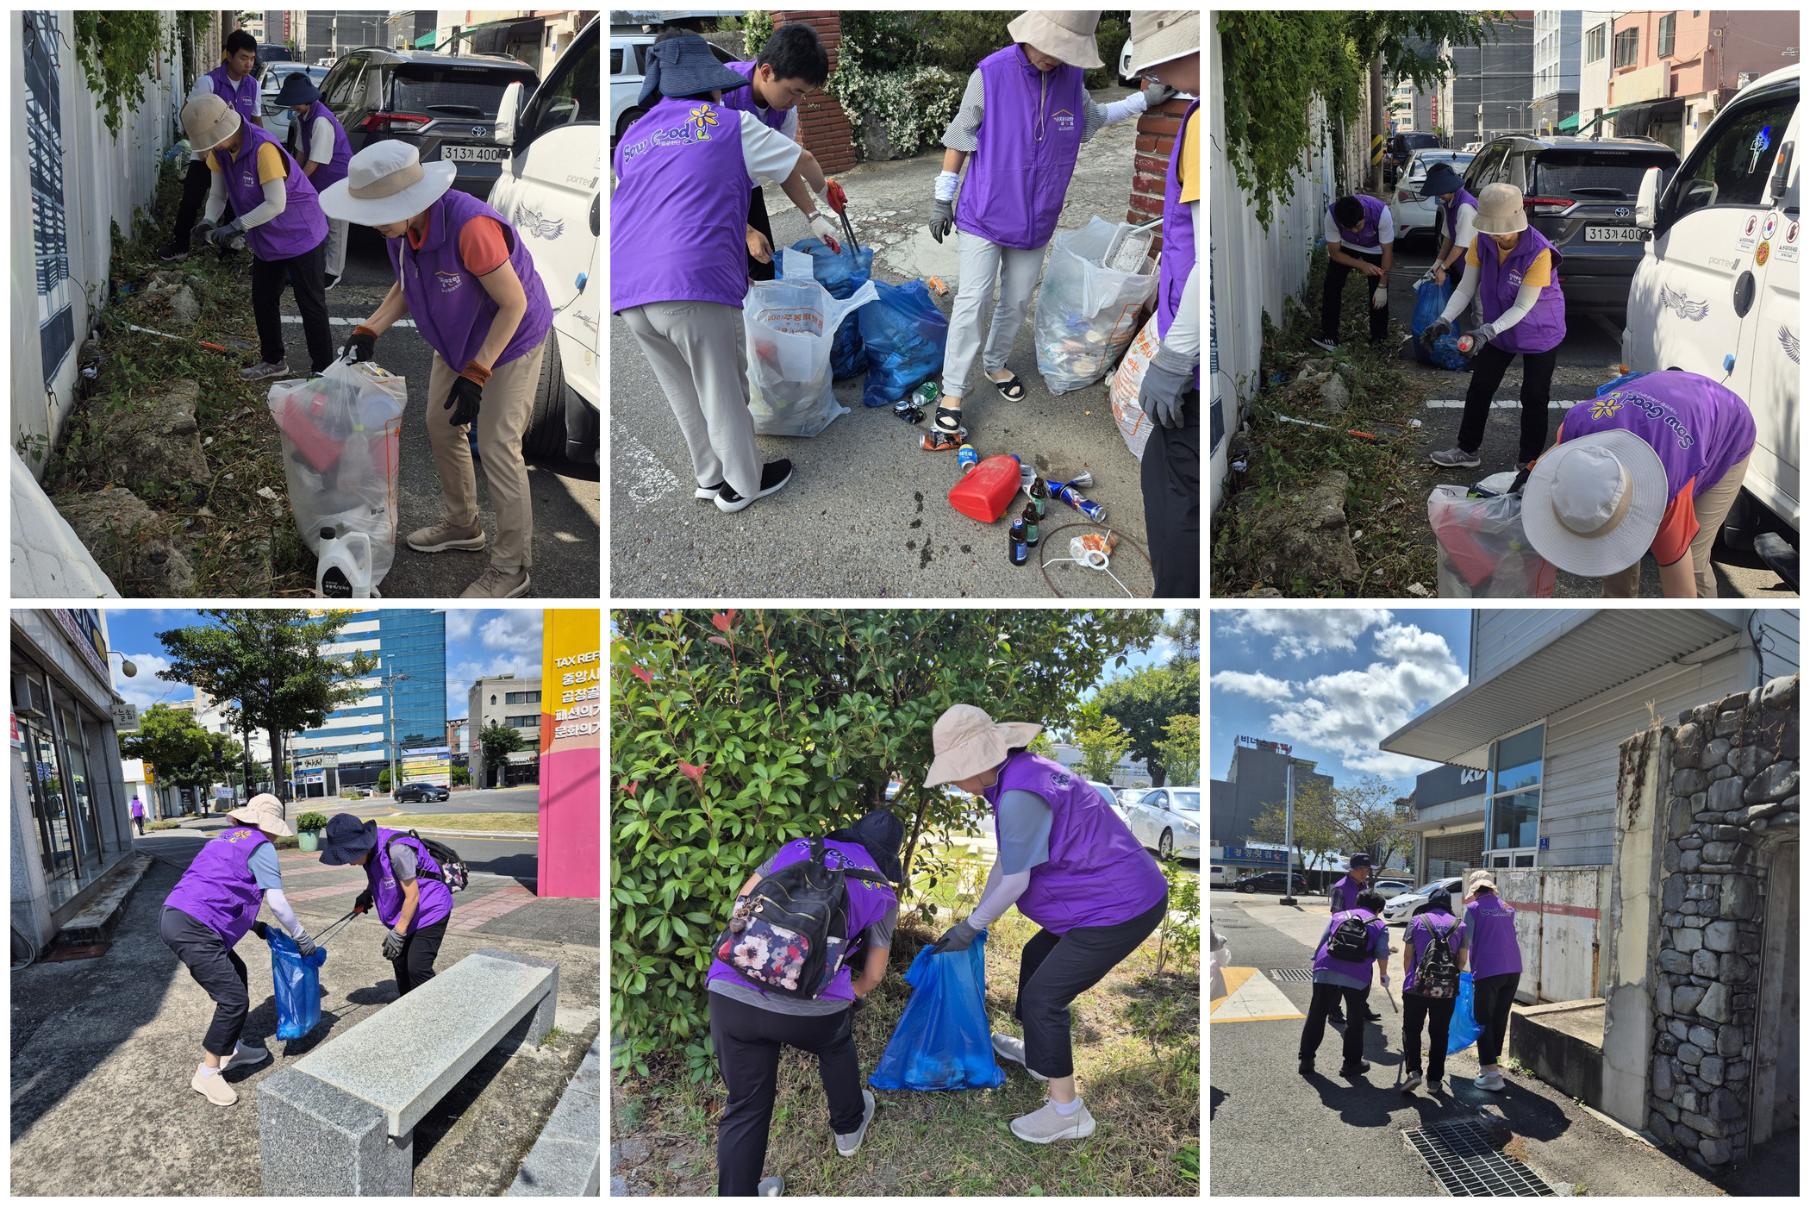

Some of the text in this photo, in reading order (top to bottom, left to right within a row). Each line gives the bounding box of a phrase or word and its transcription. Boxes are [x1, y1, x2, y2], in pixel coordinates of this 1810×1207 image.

[477, 149, 501, 161] 400
[624, 122, 691, 164] Sow Good
[1626, 391, 1664, 419] Good
[1664, 415, 1694, 449] Sow
[555, 655, 576, 668] TAX
